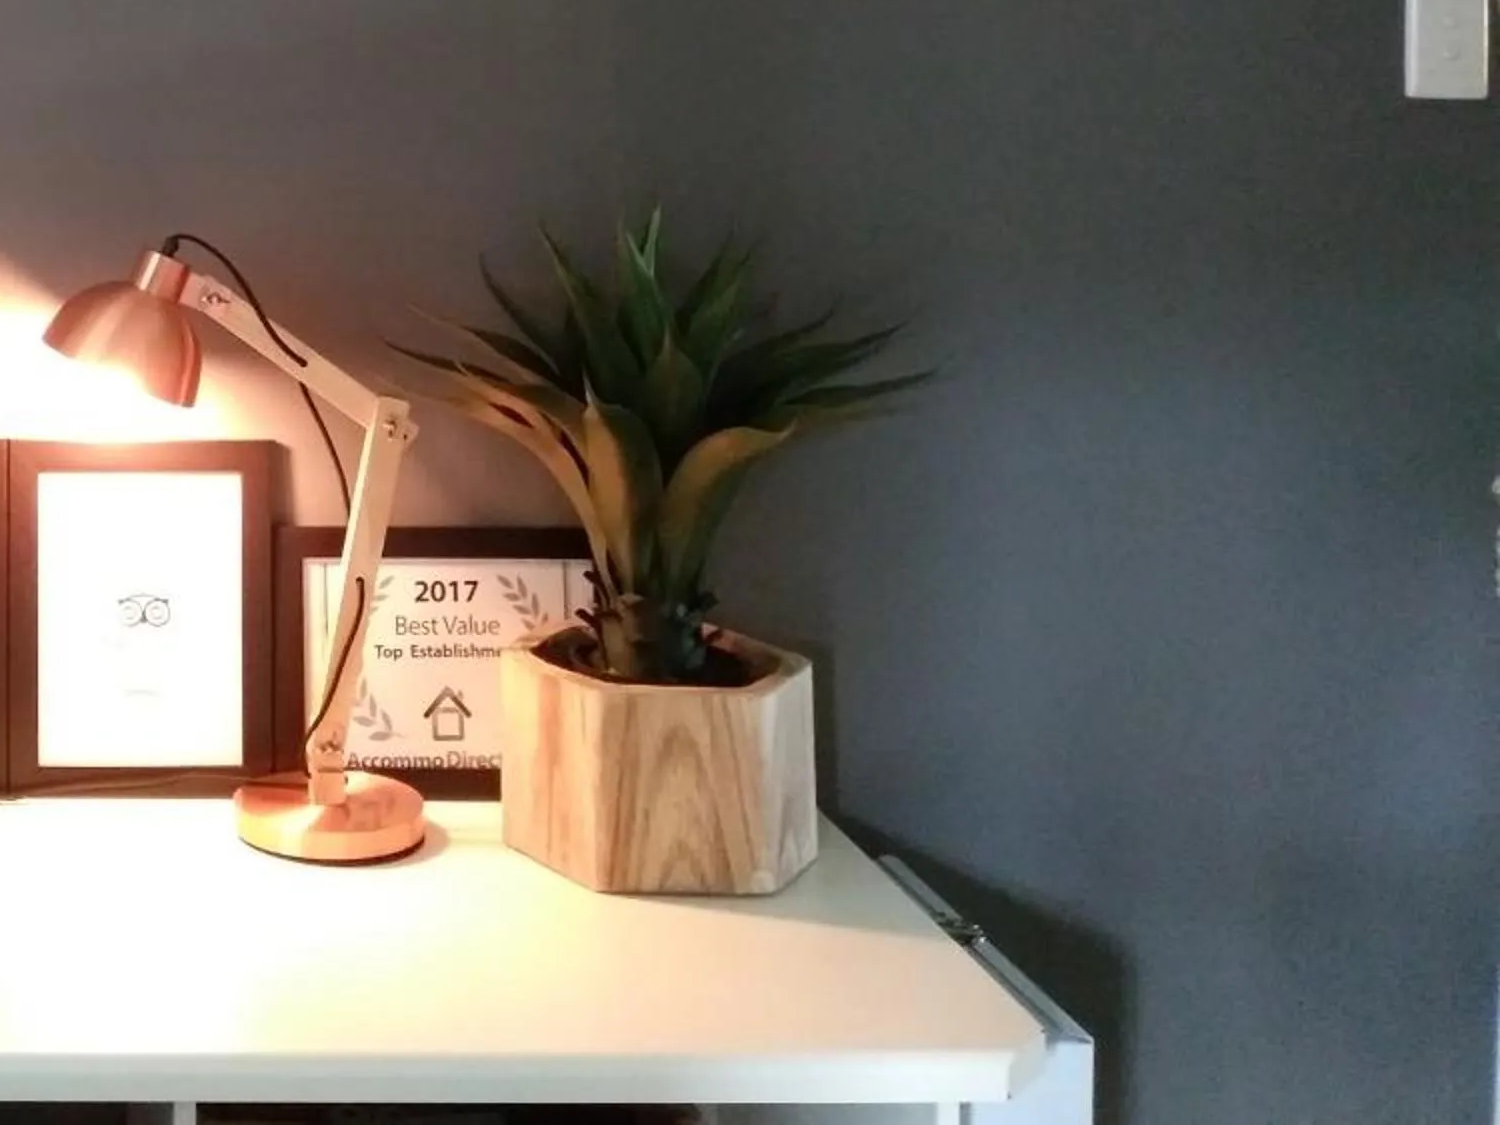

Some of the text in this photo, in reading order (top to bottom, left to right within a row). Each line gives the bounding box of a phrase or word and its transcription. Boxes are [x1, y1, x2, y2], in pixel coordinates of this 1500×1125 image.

[414, 580, 479, 603] 2017
[394, 615, 500, 636] Best Value
[374, 644, 403, 661] Top
